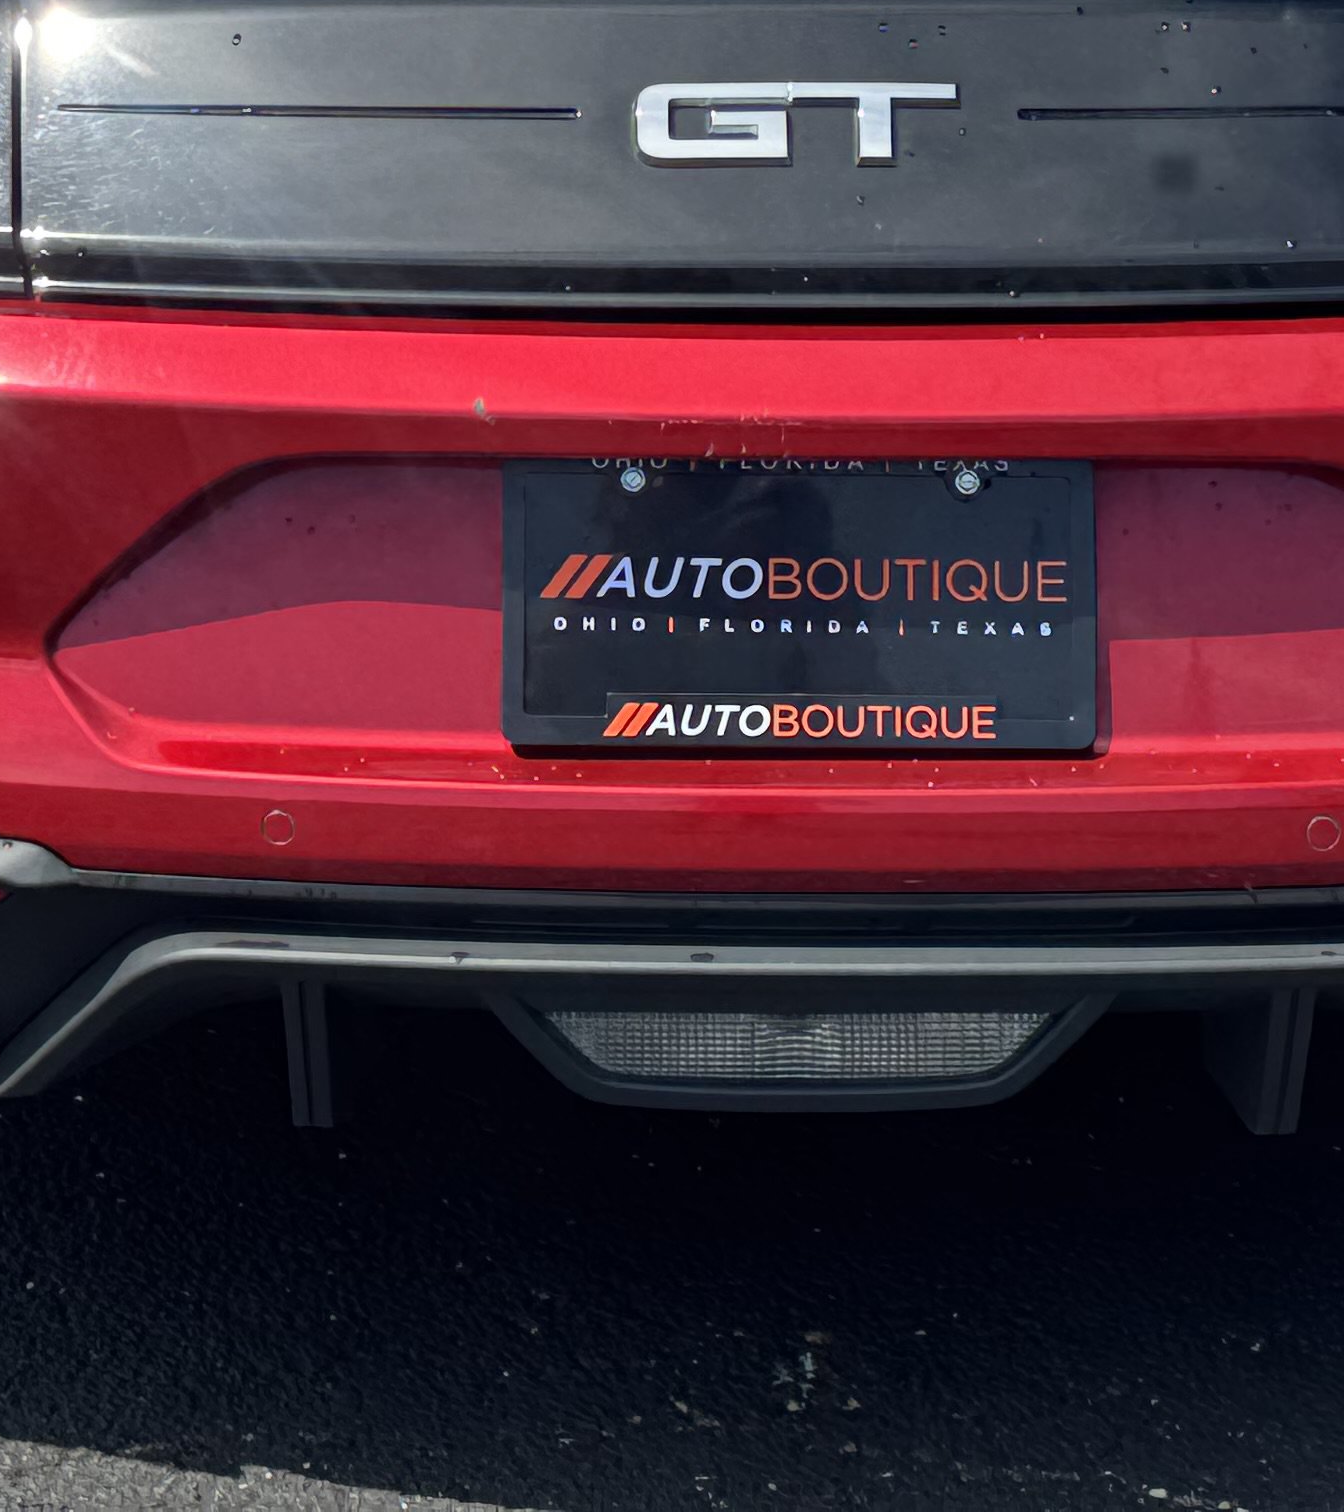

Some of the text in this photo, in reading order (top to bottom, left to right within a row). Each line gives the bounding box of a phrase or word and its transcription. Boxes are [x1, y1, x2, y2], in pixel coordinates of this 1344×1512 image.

[633, 82, 961, 168] GT
[596, 556, 1068, 602] AUTOBOUTIQUE
[553, 616, 646, 632] OHIO
[698, 617, 870, 634] FLORIDA
[929, 619, 1053, 637] TEXAS
[644, 703, 997, 739] AUTOBOUTIQUE
